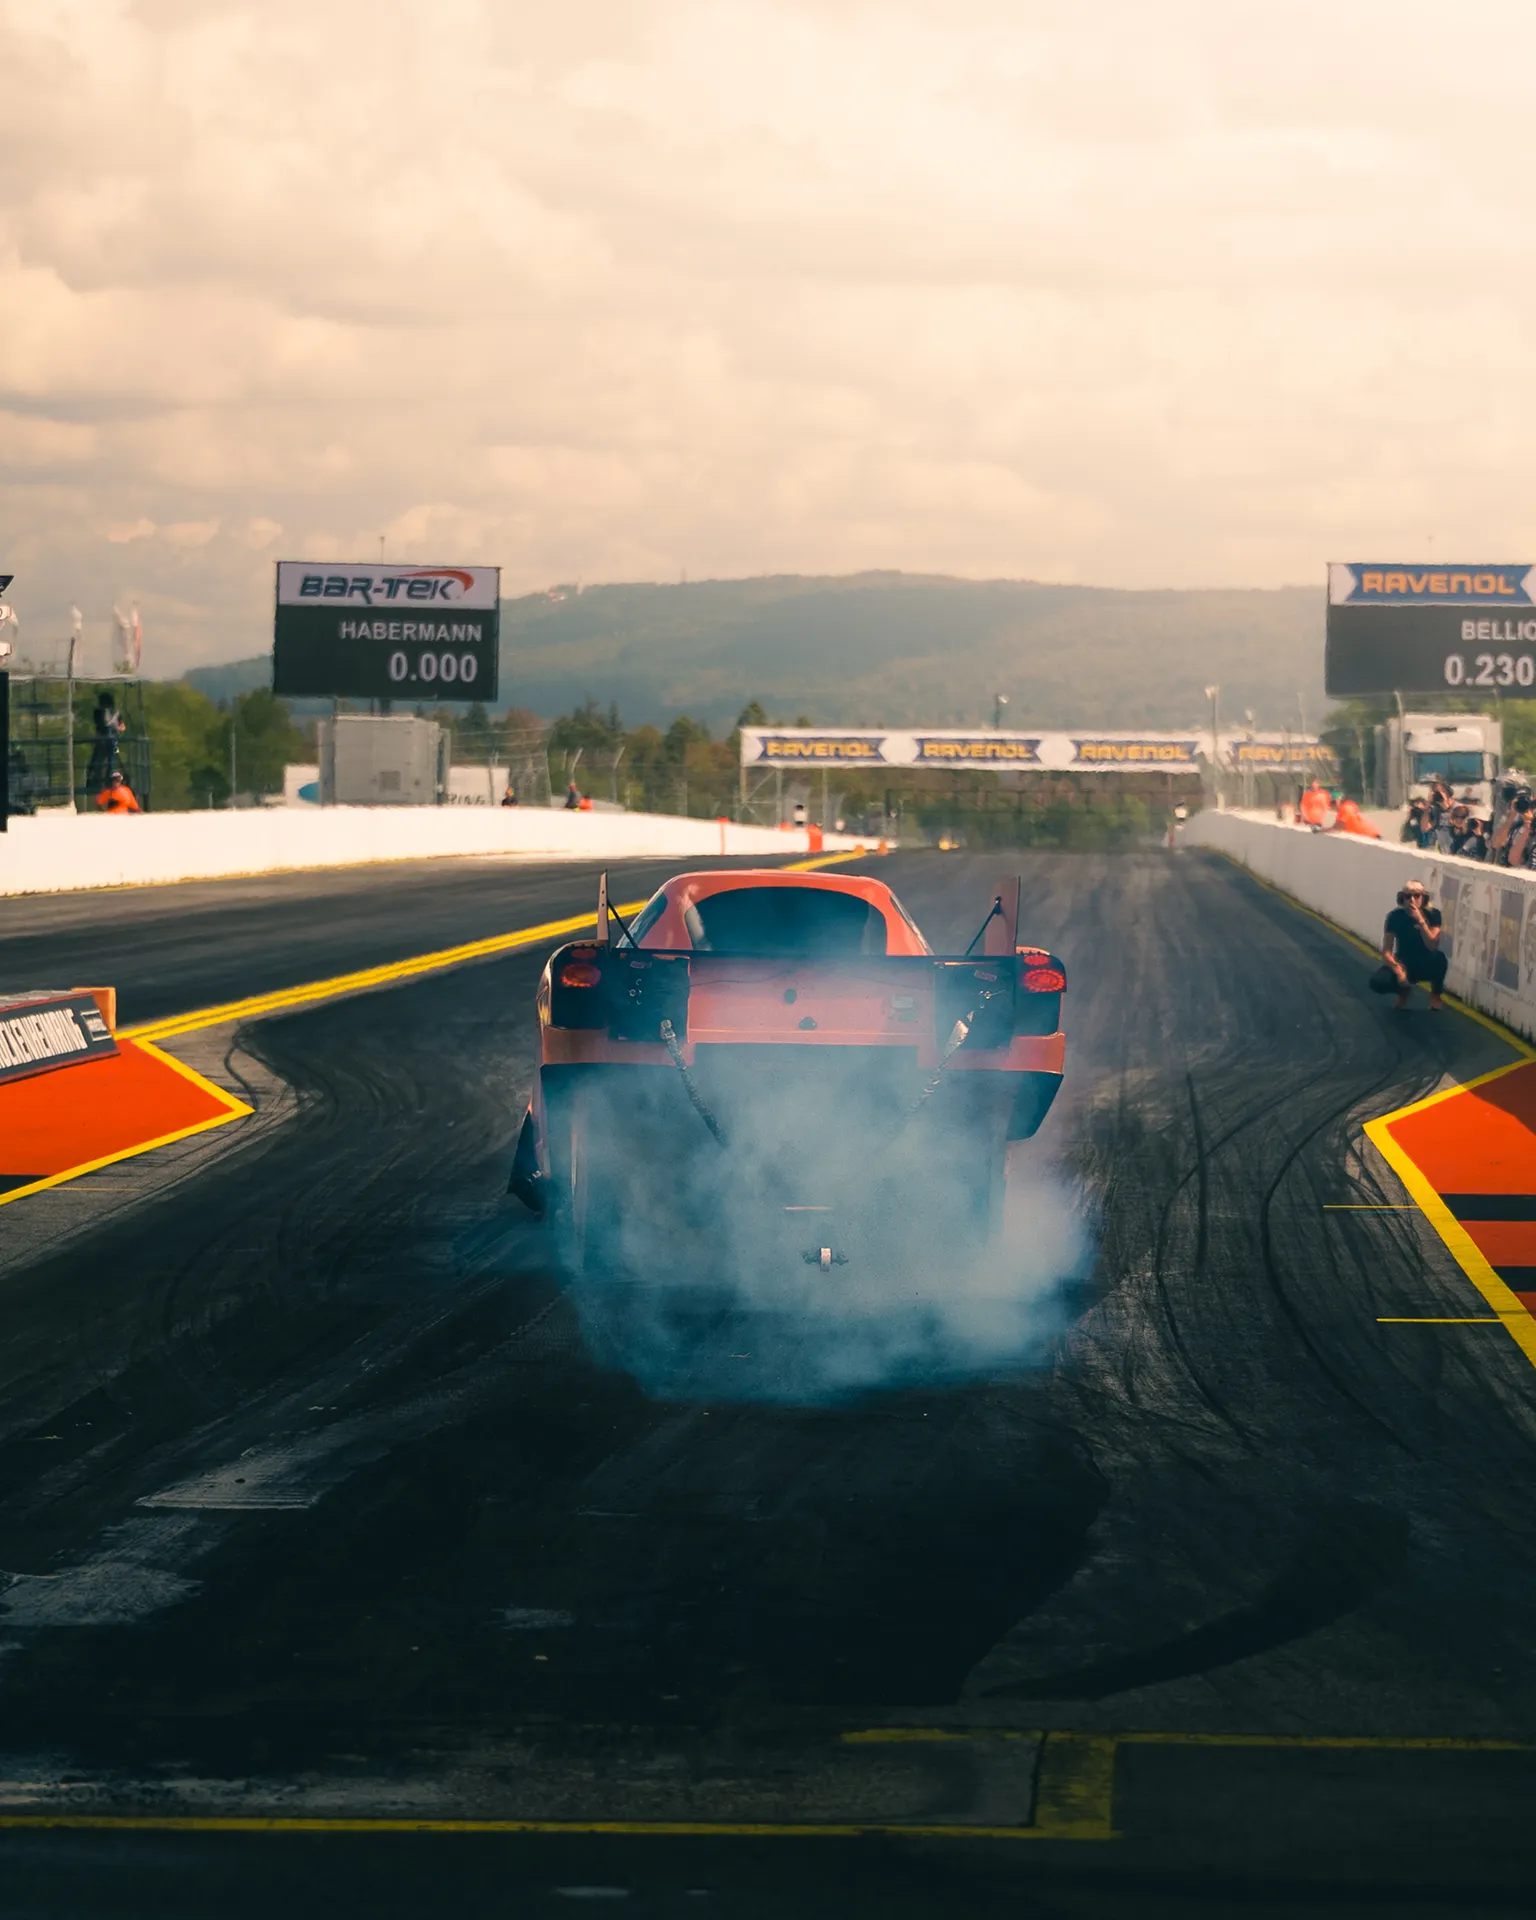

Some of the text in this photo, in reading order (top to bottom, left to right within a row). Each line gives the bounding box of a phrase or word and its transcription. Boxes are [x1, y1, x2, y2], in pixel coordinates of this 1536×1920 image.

[1362, 571, 1516, 595] RAVENOL
[339, 620, 482, 642] HABERMANN
[389, 652, 478, 683] 0.000
[1444, 654, 1534, 686] 0.230
[766, 741, 875, 757] RAVENOL
[923, 743, 1033, 759] RAVENOL
[1079, 744, 1189, 761] RAVENOL
